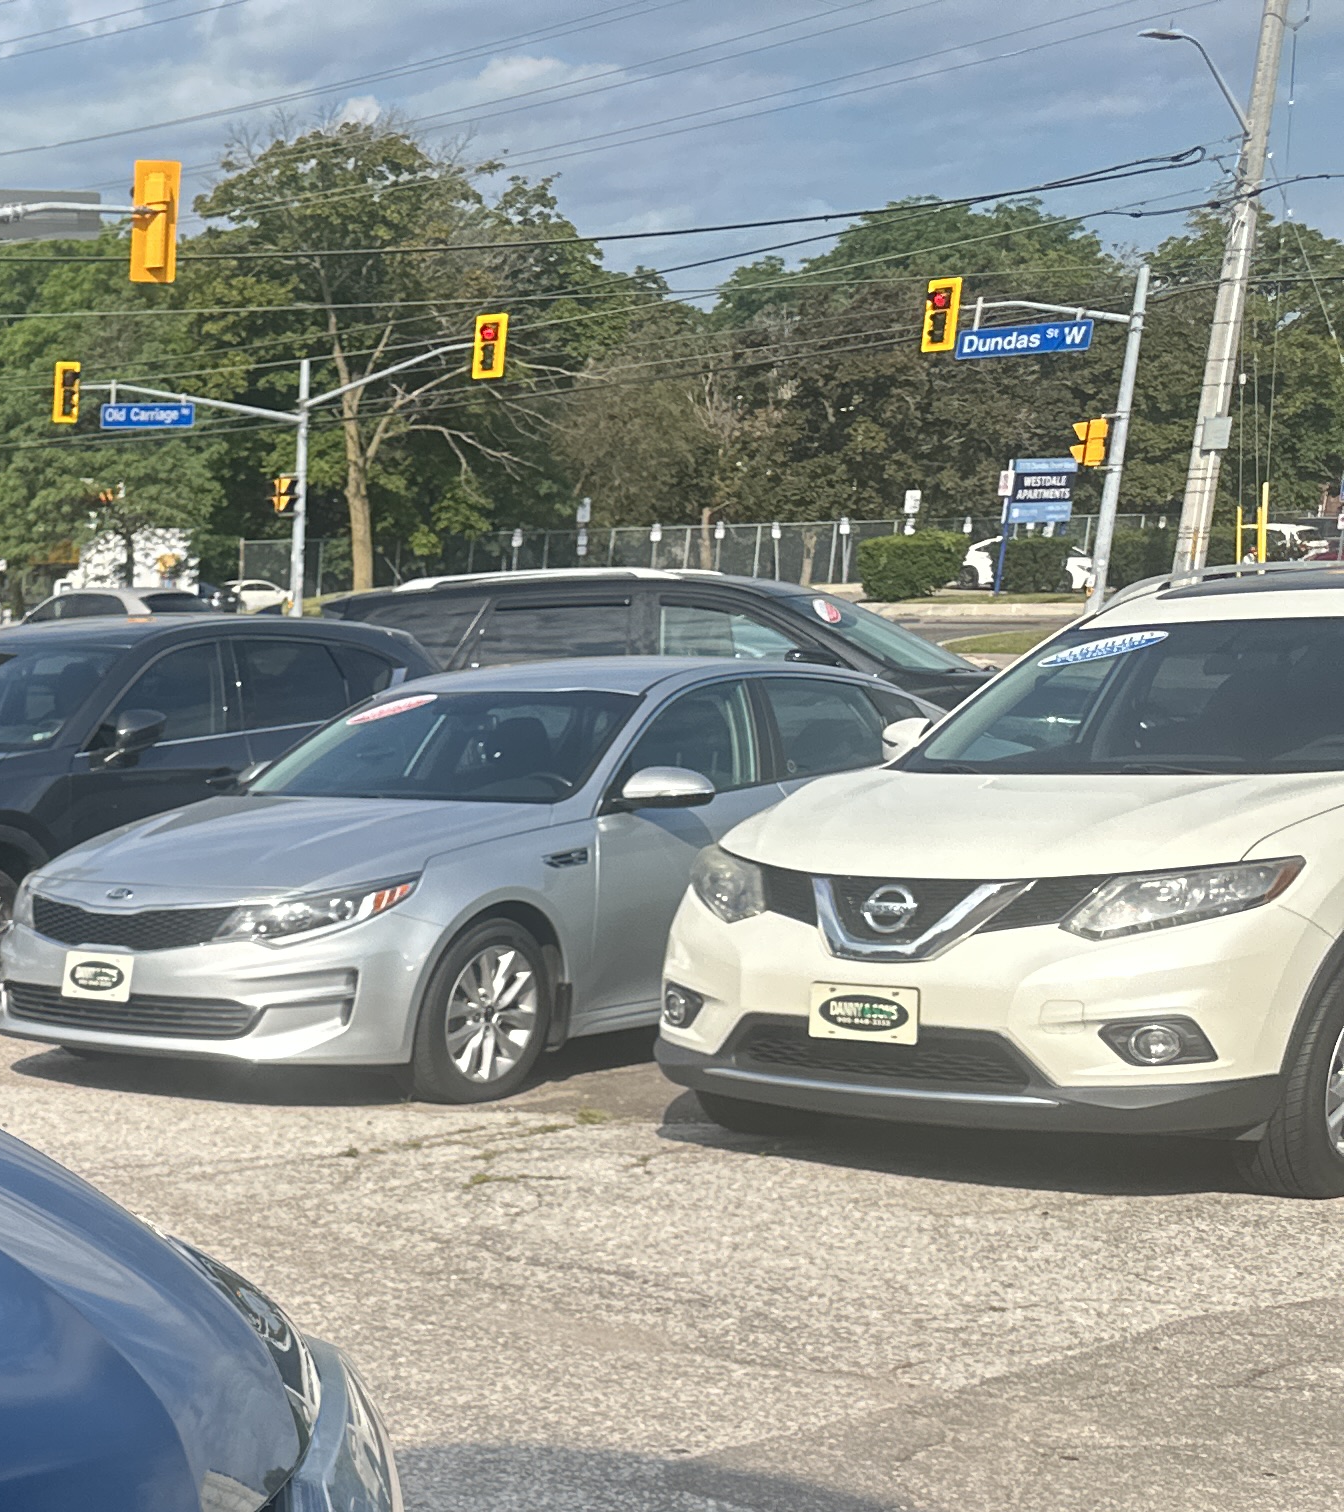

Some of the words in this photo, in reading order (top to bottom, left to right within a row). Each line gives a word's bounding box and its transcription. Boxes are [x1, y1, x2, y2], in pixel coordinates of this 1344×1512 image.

[962, 332, 1041, 354] Dundas
[1045, 327, 1059, 339] St
[1063, 326, 1087, 346] W
[104, 408, 127, 422] Old
[130, 407, 180, 424] Carriage
[1023, 475, 1067, 488] WESTDALE
[1016, 487, 1071, 501] APARTMENTS
